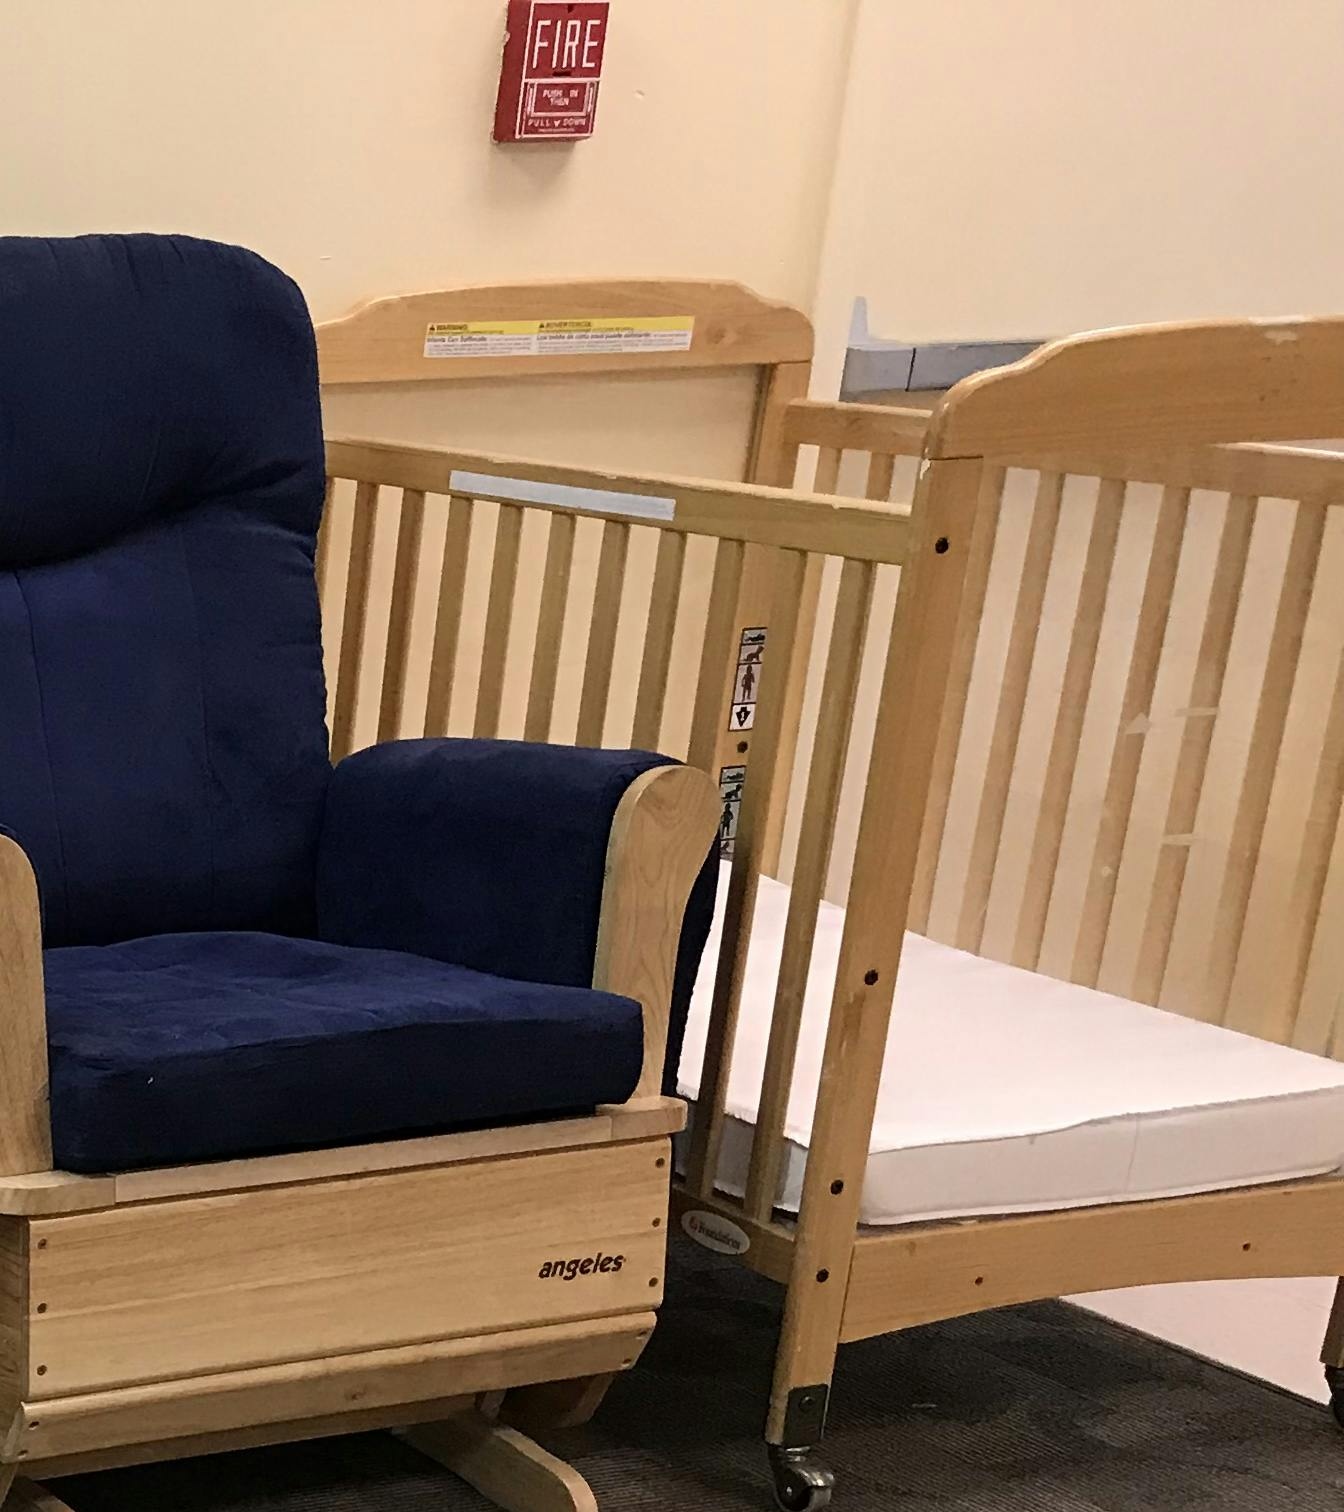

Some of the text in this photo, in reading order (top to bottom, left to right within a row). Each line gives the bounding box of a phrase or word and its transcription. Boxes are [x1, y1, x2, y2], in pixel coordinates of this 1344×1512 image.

[532, 19, 602, 69] FIRE
[528, 118, 587, 127] PULL DOWN
[538, 1252, 625, 1281] angeles
